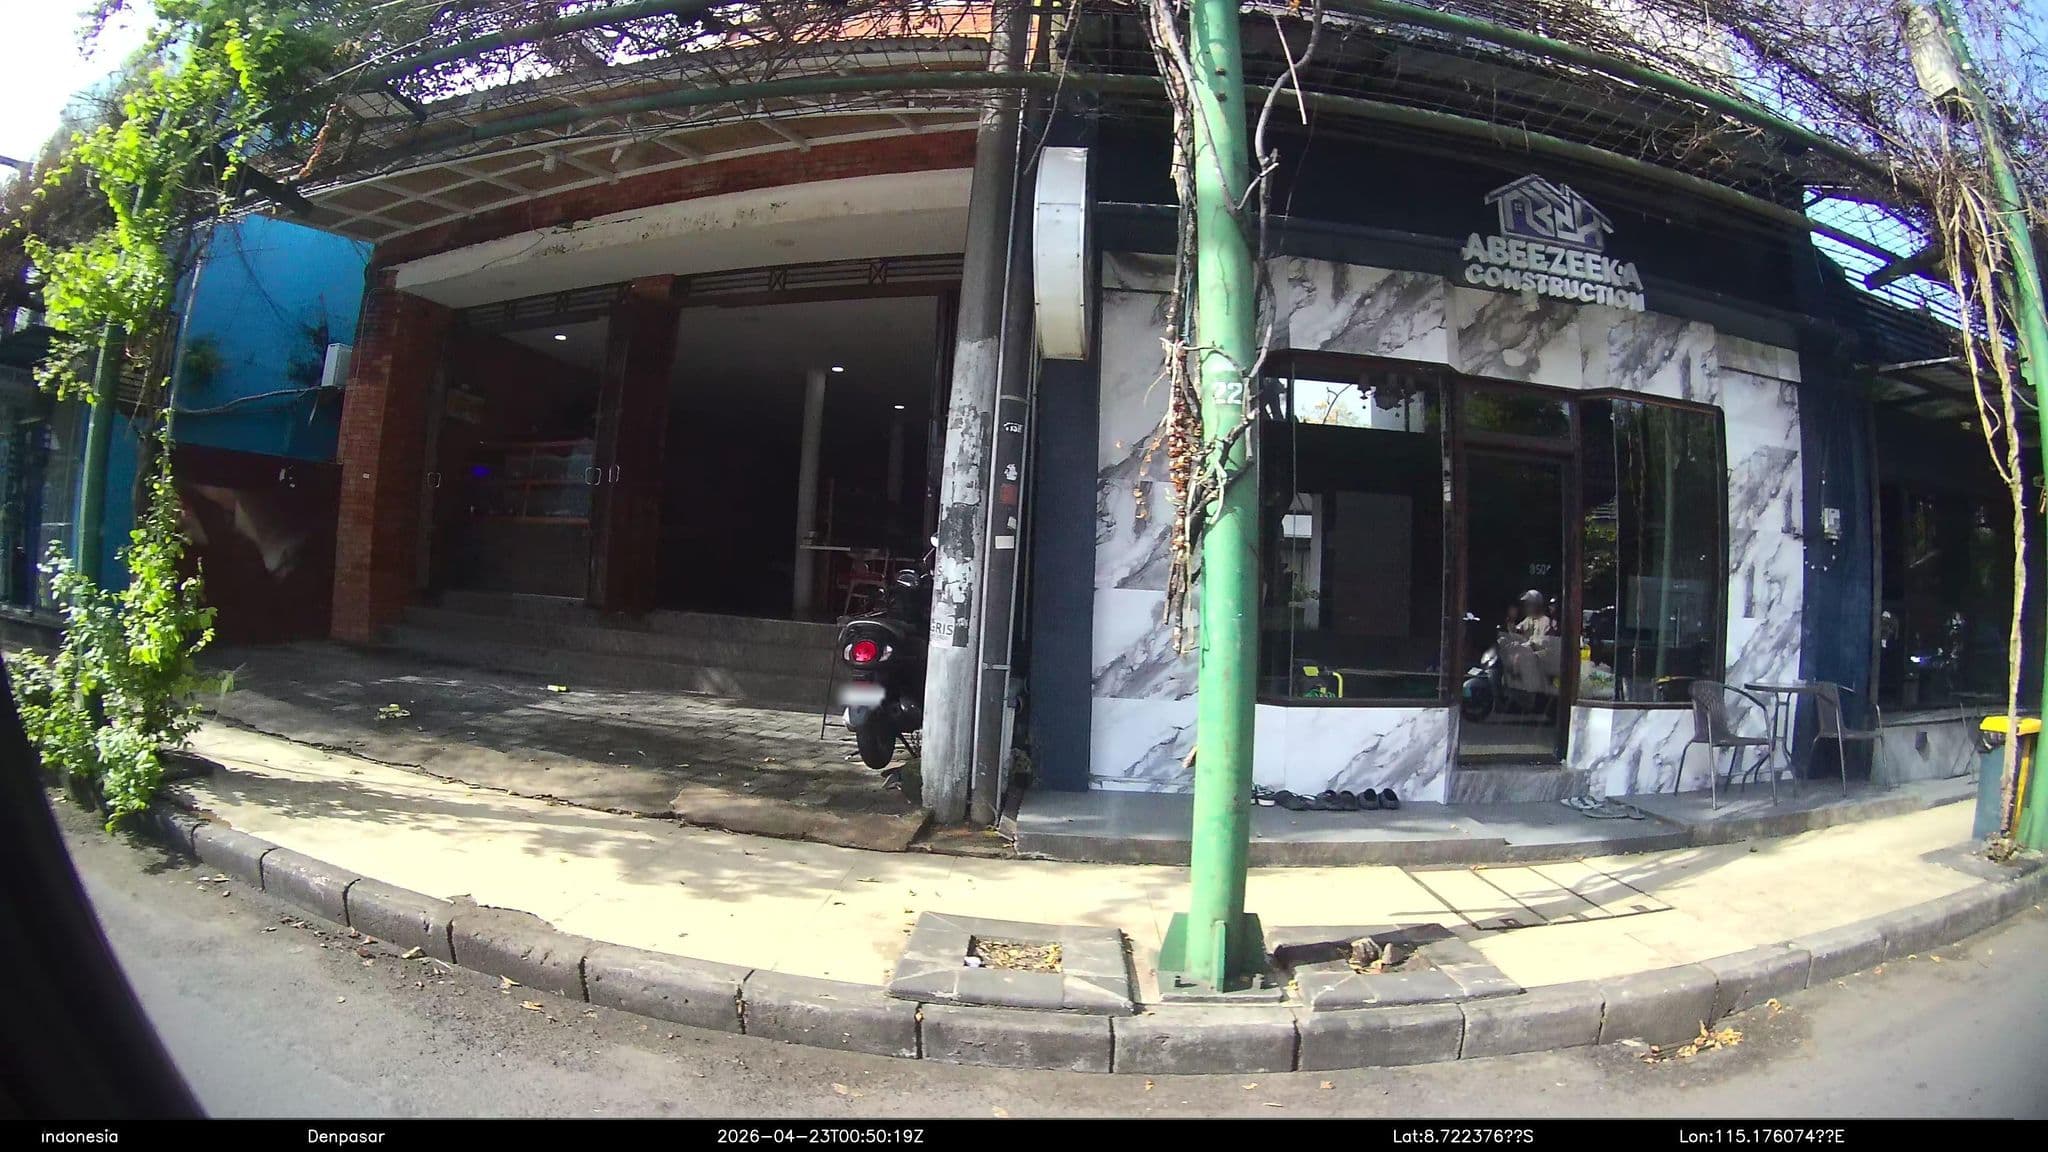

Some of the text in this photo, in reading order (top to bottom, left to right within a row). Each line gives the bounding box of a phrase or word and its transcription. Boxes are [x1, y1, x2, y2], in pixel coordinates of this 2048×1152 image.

[1462, 231, 1644, 291] ABEEZEEKA
[1464, 264, 1645, 312] CONSTRUCTION
[1215, 381, 1243, 405] 22
